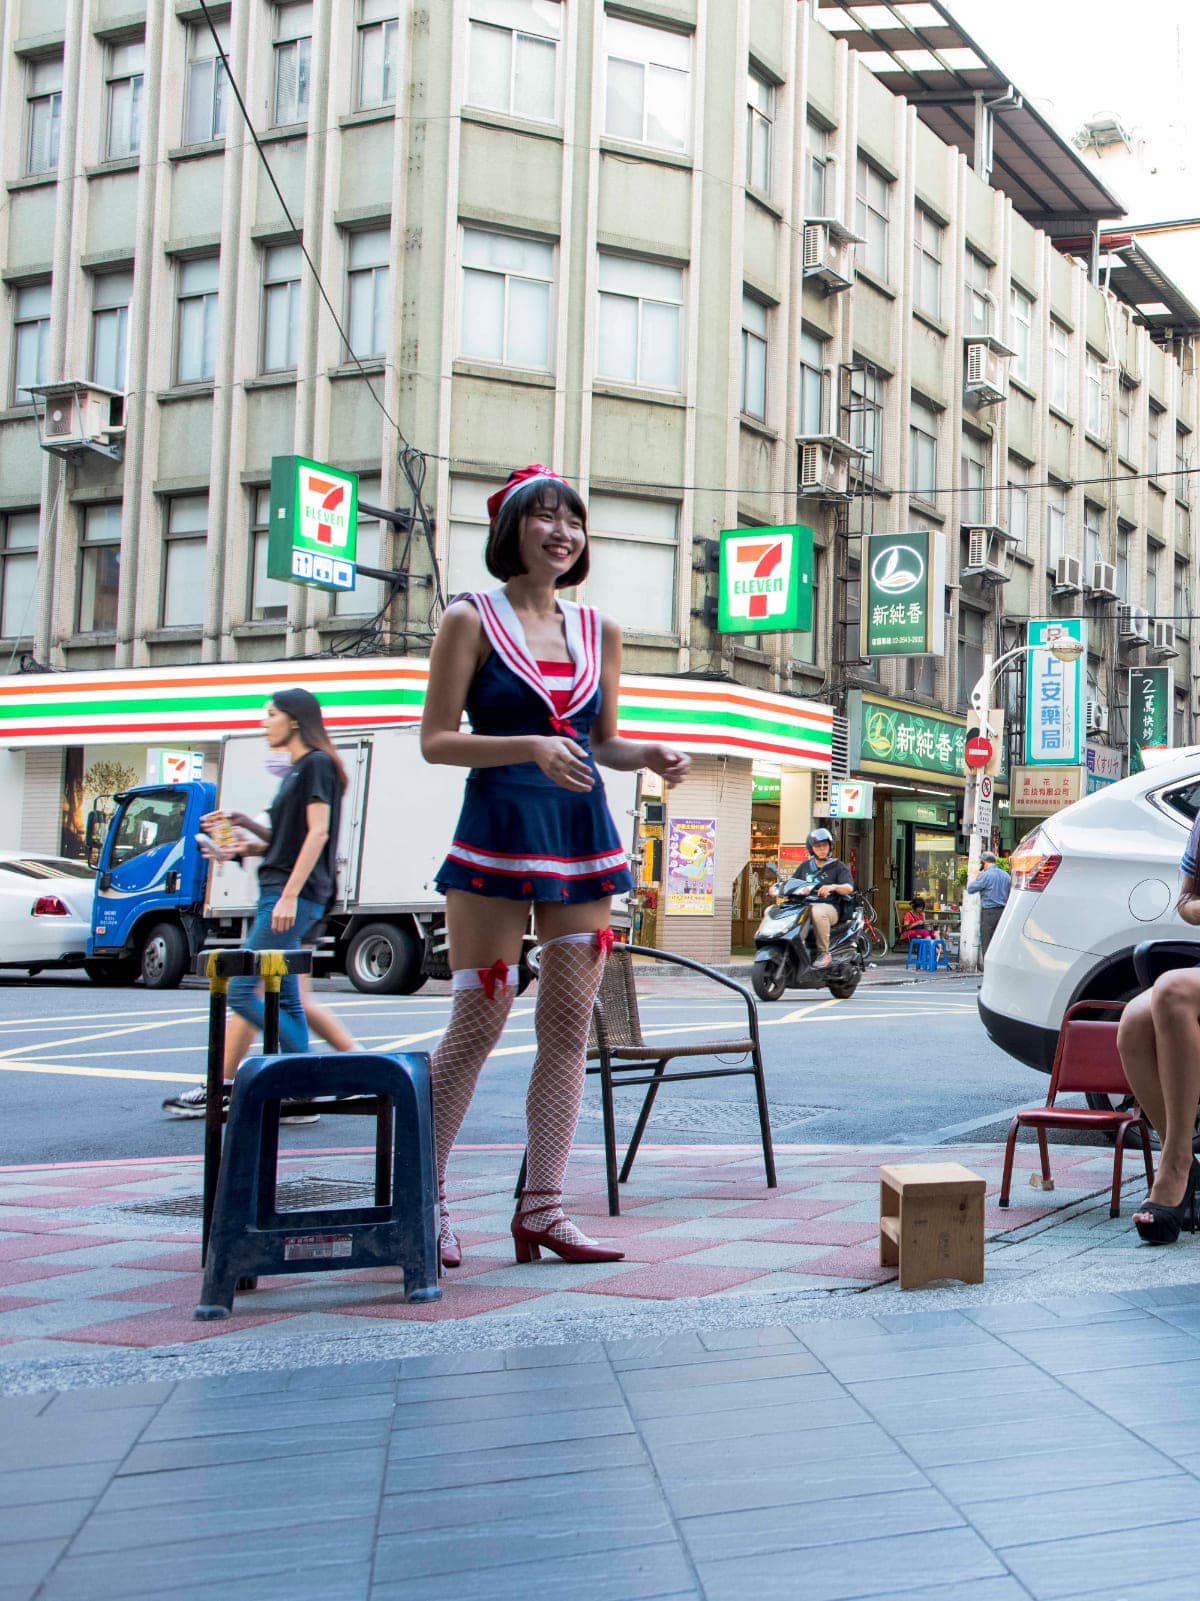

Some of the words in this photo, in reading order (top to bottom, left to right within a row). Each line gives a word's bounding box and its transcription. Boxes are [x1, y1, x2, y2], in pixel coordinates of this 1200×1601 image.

[872, 602, 923, 626] 新純香
[1041, 656, 1062, 751] 上安藥局
[896, 722, 954, 764] 新純香
